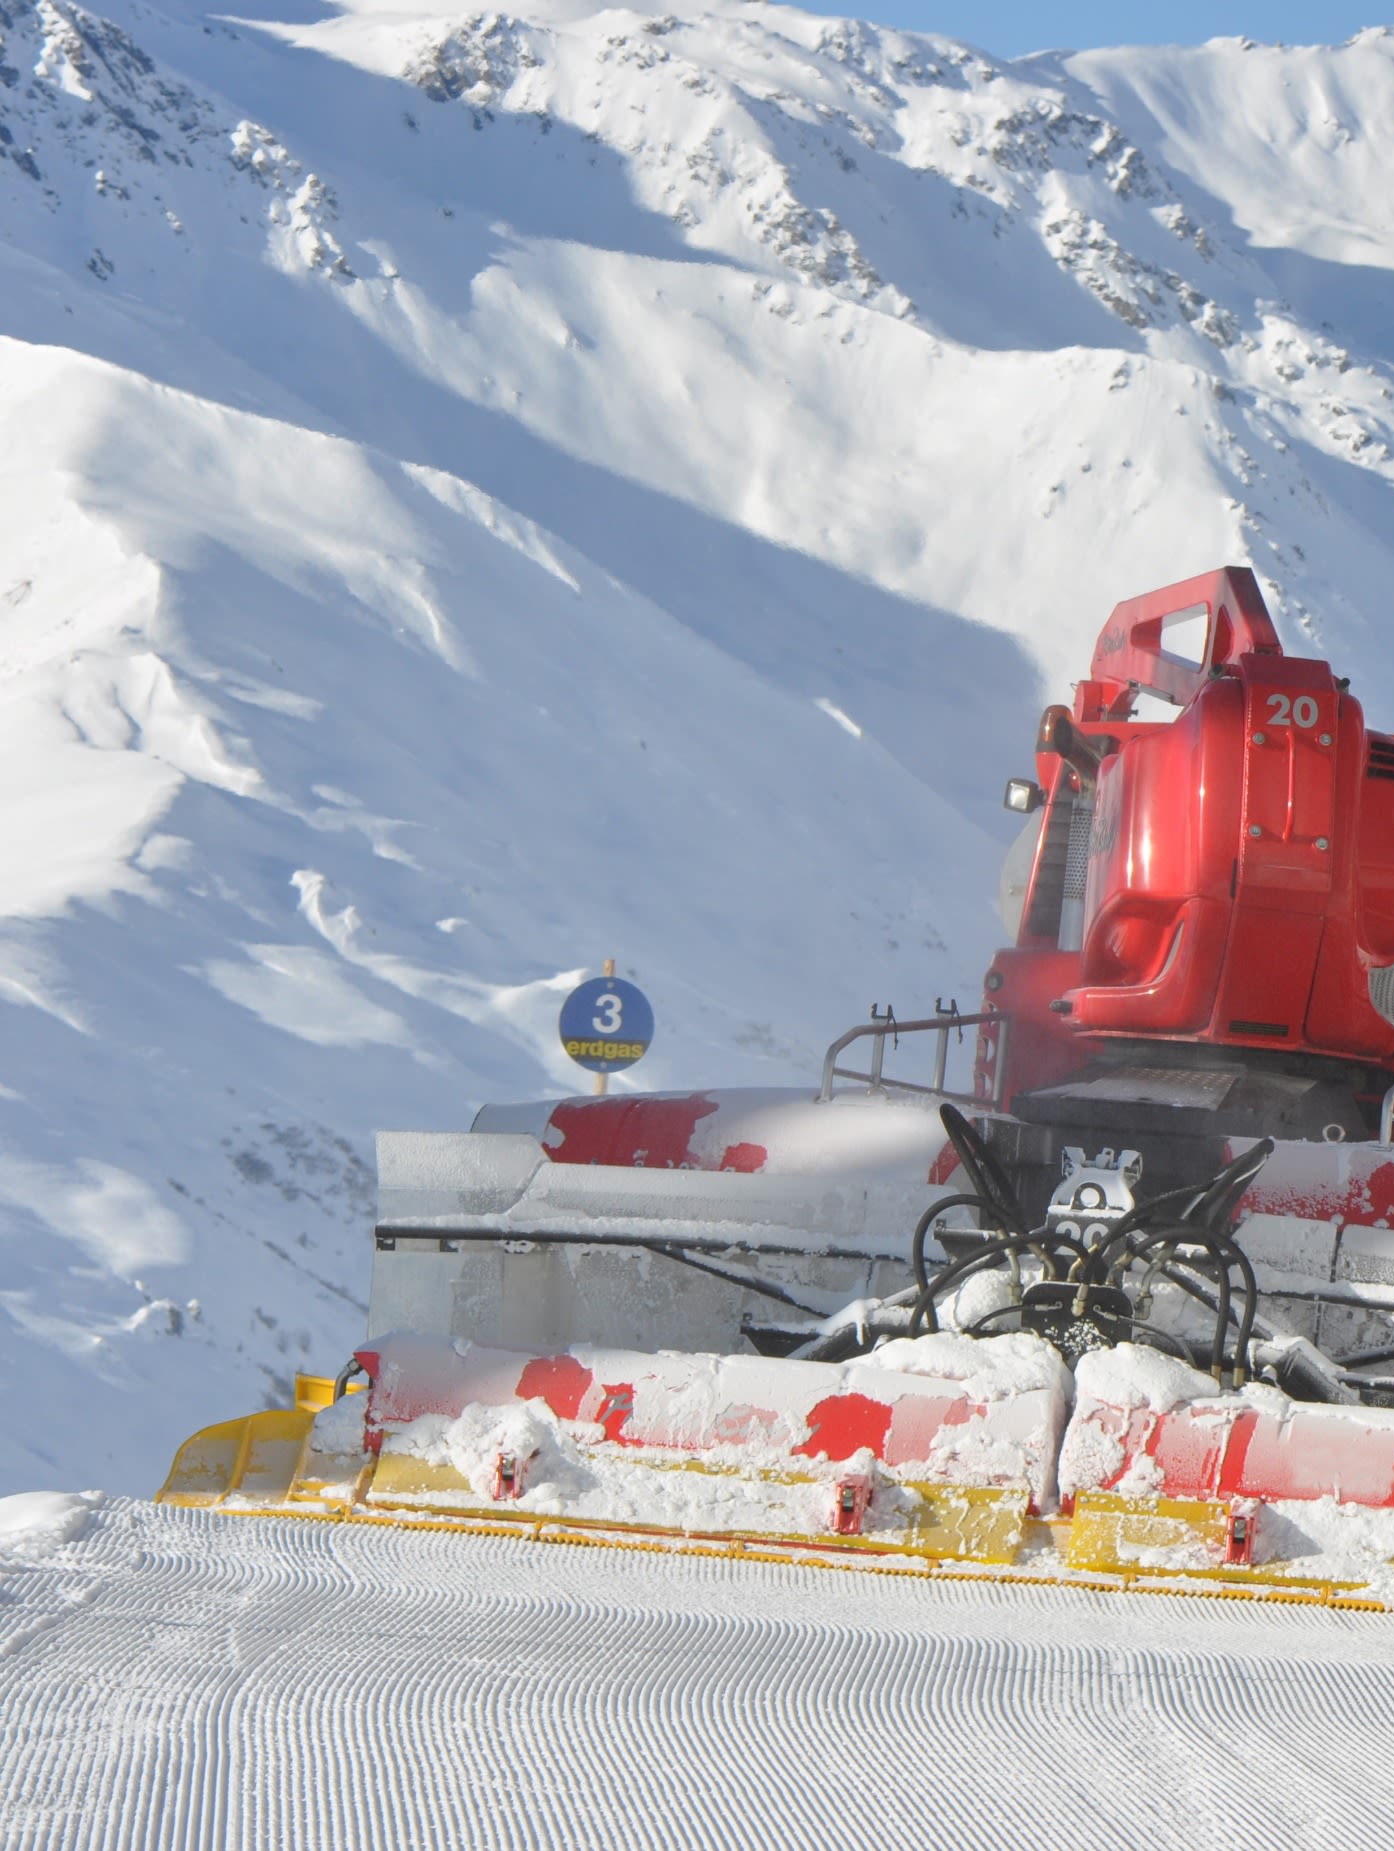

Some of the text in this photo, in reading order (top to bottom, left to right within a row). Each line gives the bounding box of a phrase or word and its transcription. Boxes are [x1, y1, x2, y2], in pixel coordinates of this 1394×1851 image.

[1266, 693, 1319, 728] 20
[592, 993, 623, 1034] 3
[566, 1040, 644, 1060] erdgas
